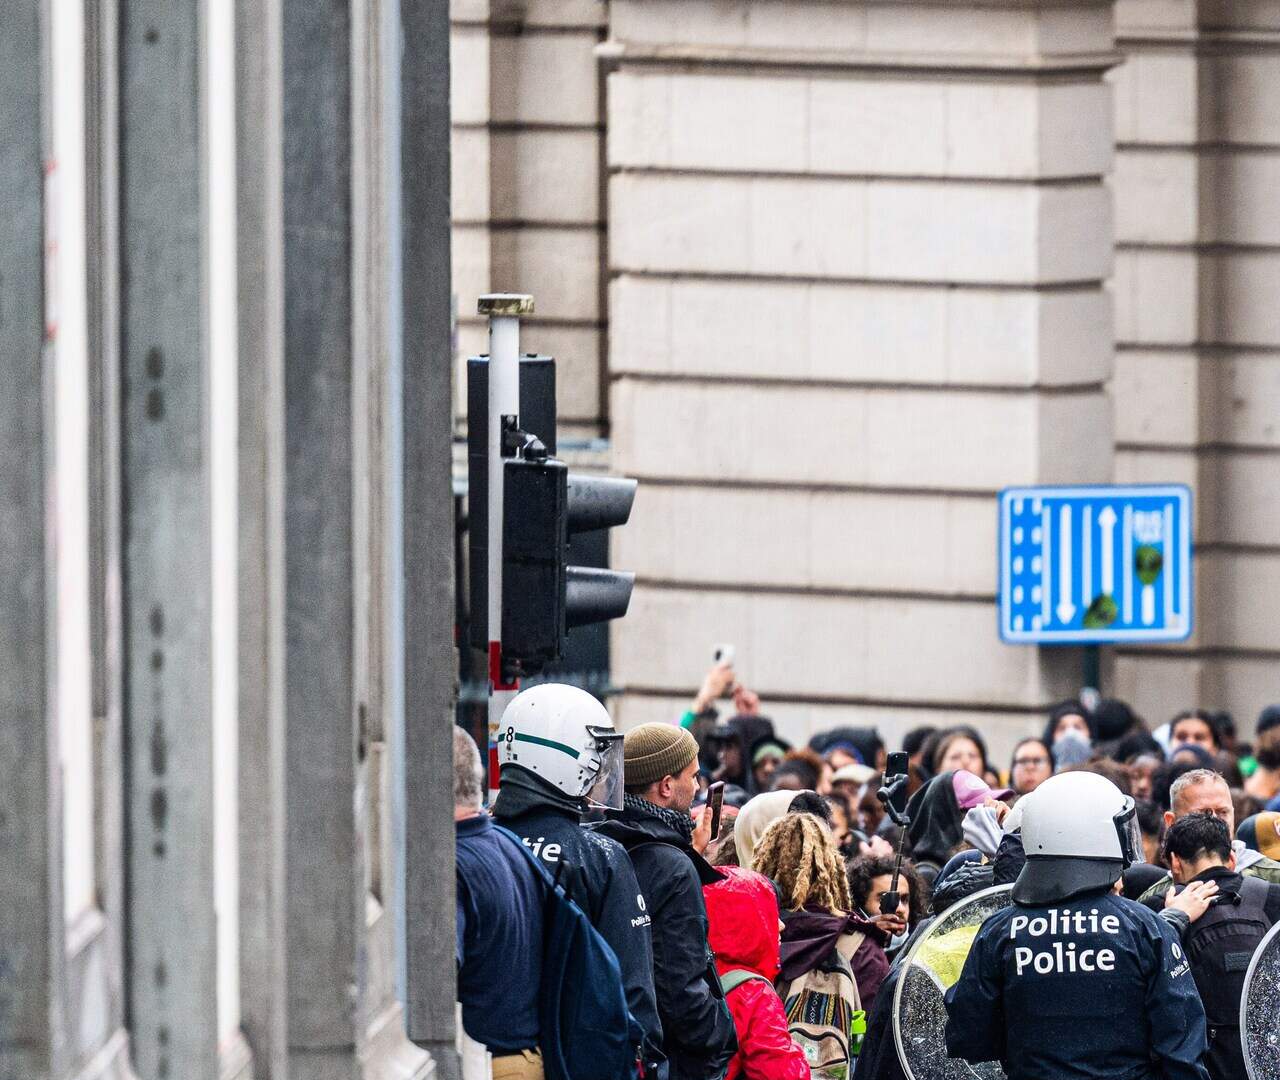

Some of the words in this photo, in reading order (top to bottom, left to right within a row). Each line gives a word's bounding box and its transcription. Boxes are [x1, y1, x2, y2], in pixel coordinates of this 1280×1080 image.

[505, 726, 514, 743] 8
[1010, 907, 1120, 940] Politie
[1014, 941, 1116, 976] Police
